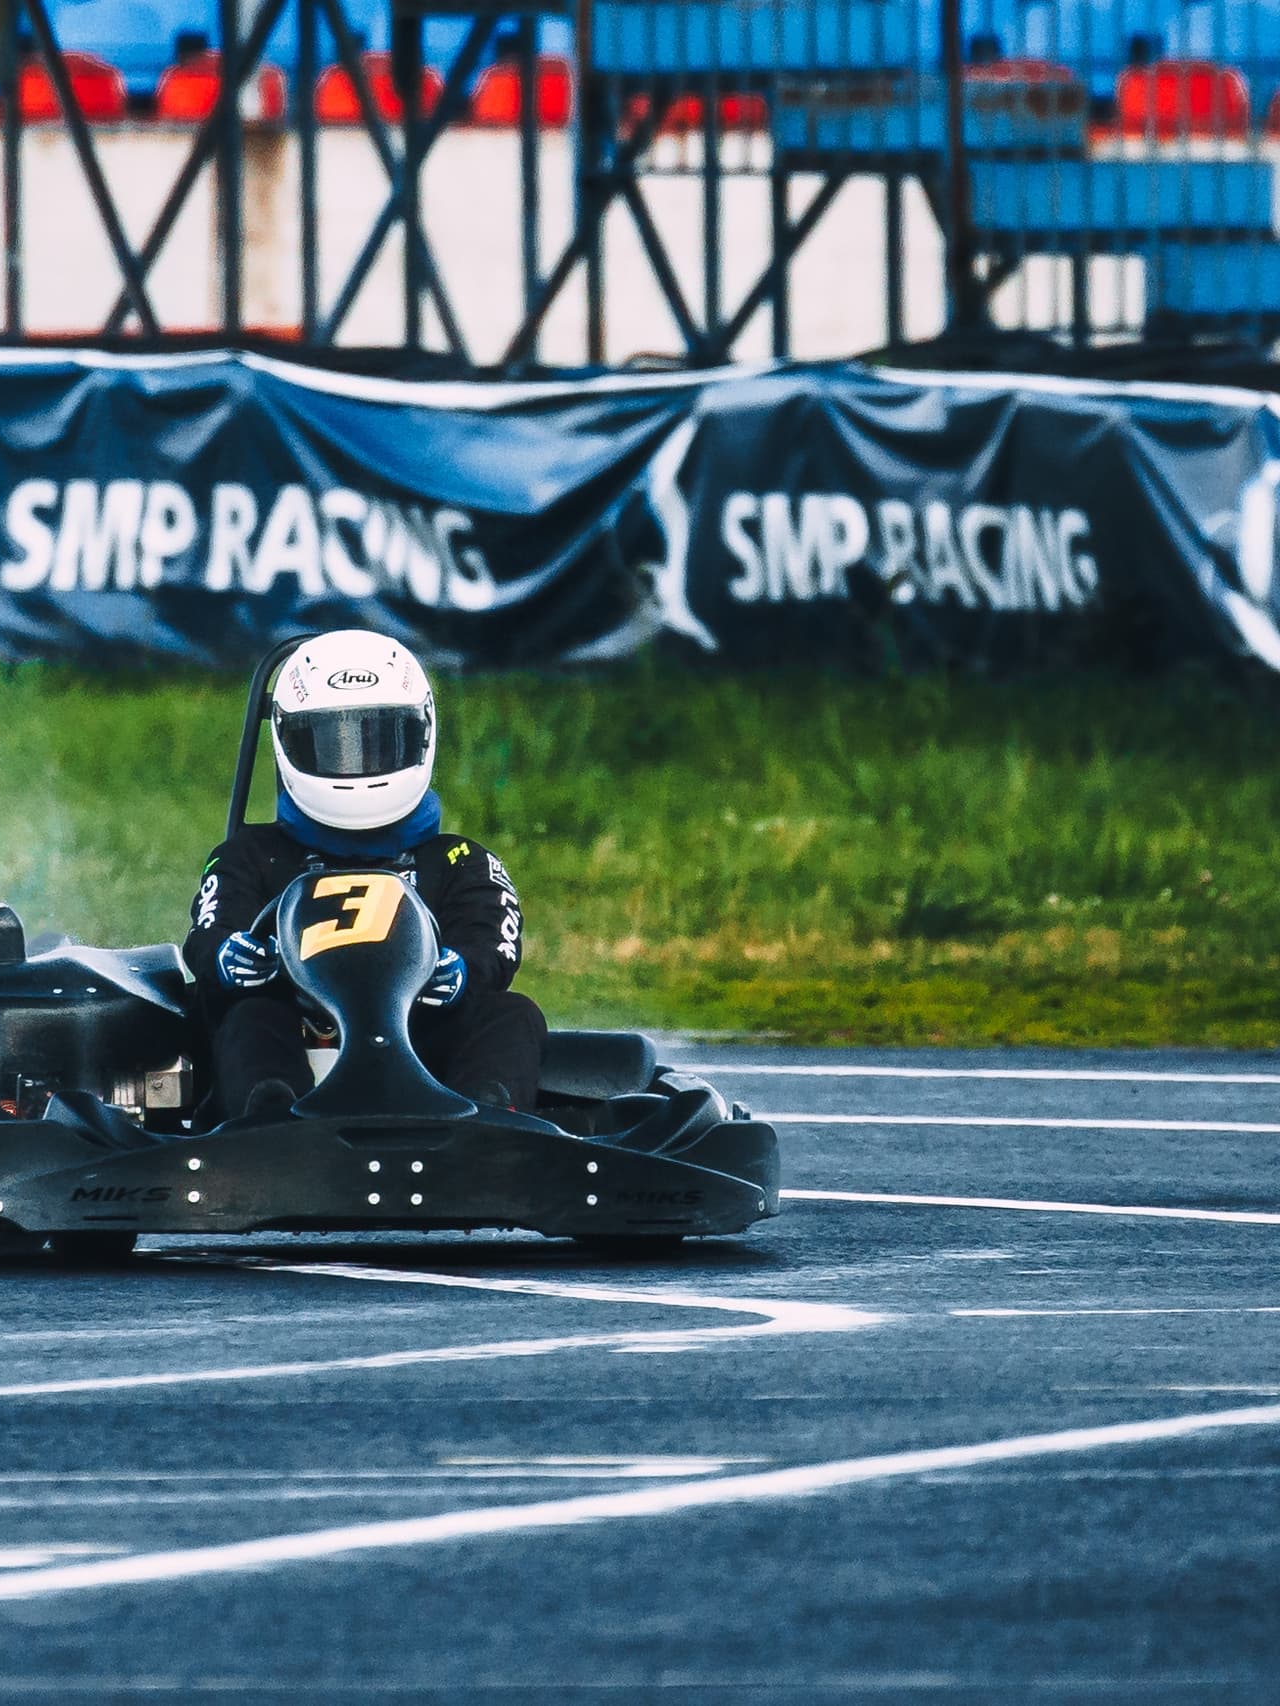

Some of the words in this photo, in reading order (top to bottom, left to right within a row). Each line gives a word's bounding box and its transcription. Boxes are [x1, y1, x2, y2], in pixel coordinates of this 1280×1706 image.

[0, 478, 197, 592] SMP
[723, 492, 870, 602] SMP
[336, 671, 373, 684] Arai
[299, 873, 407, 961] 3
[69, 1185, 173, 1203] MIKS
